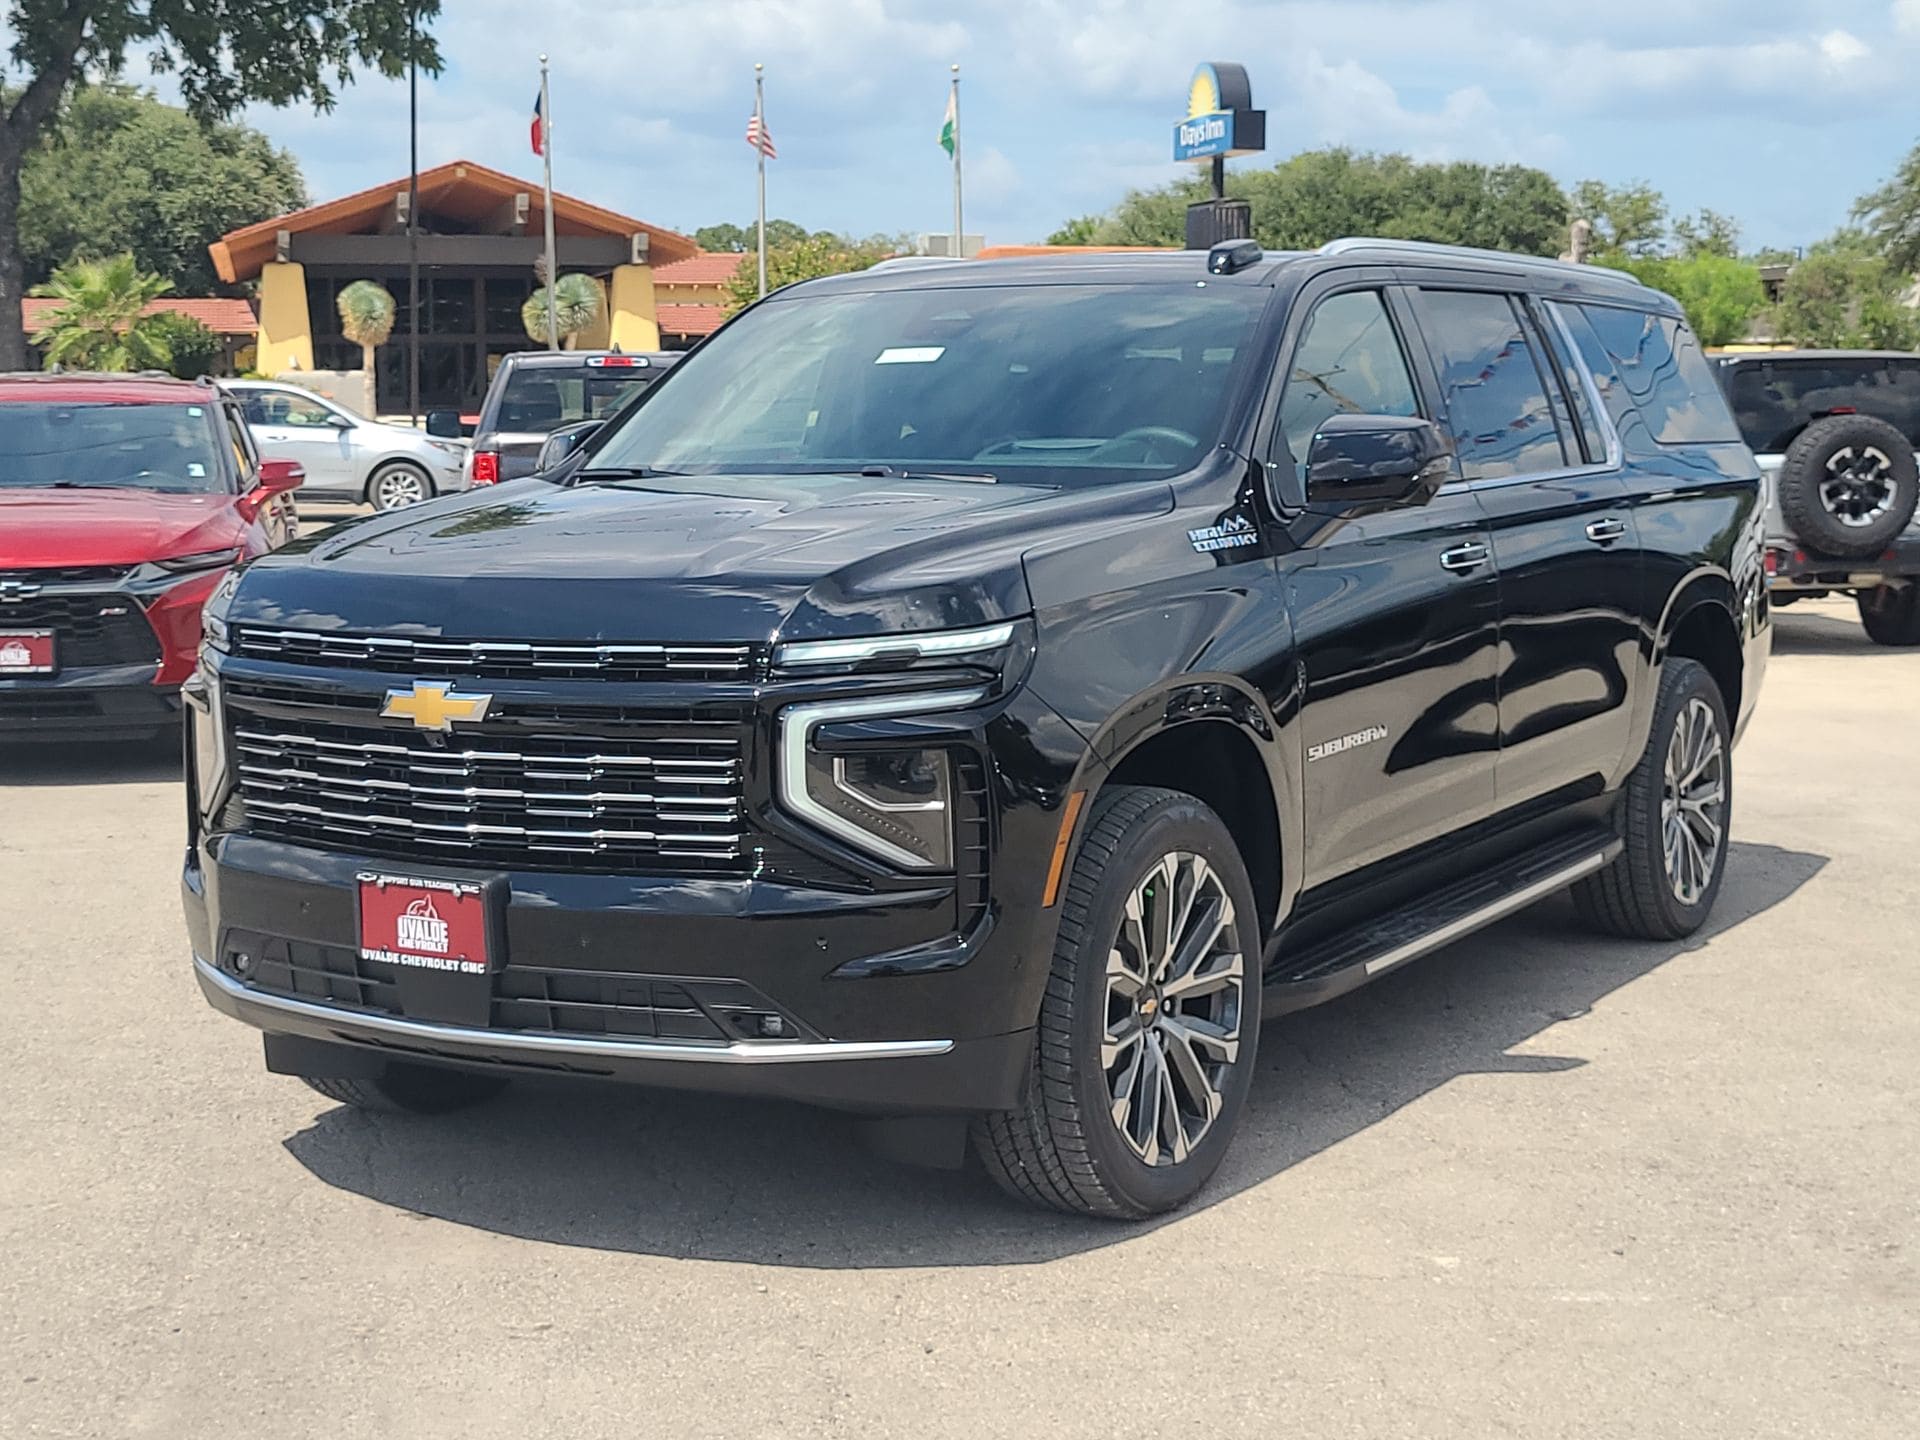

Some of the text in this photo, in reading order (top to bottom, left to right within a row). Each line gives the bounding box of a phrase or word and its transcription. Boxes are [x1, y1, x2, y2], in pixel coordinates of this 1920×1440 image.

[1180, 118, 1225, 147] Days Inn
[1187, 526, 1224, 542] HIGH
[1193, 532, 1258, 552] COUNTRY
[1307, 723, 1388, 762] SUBURBAN
[397, 917, 448, 942] UVALDE
[398, 938, 448, 953] CHEVROLET
[361, 949, 485, 975] UVALDE CHEVROLET GMC
